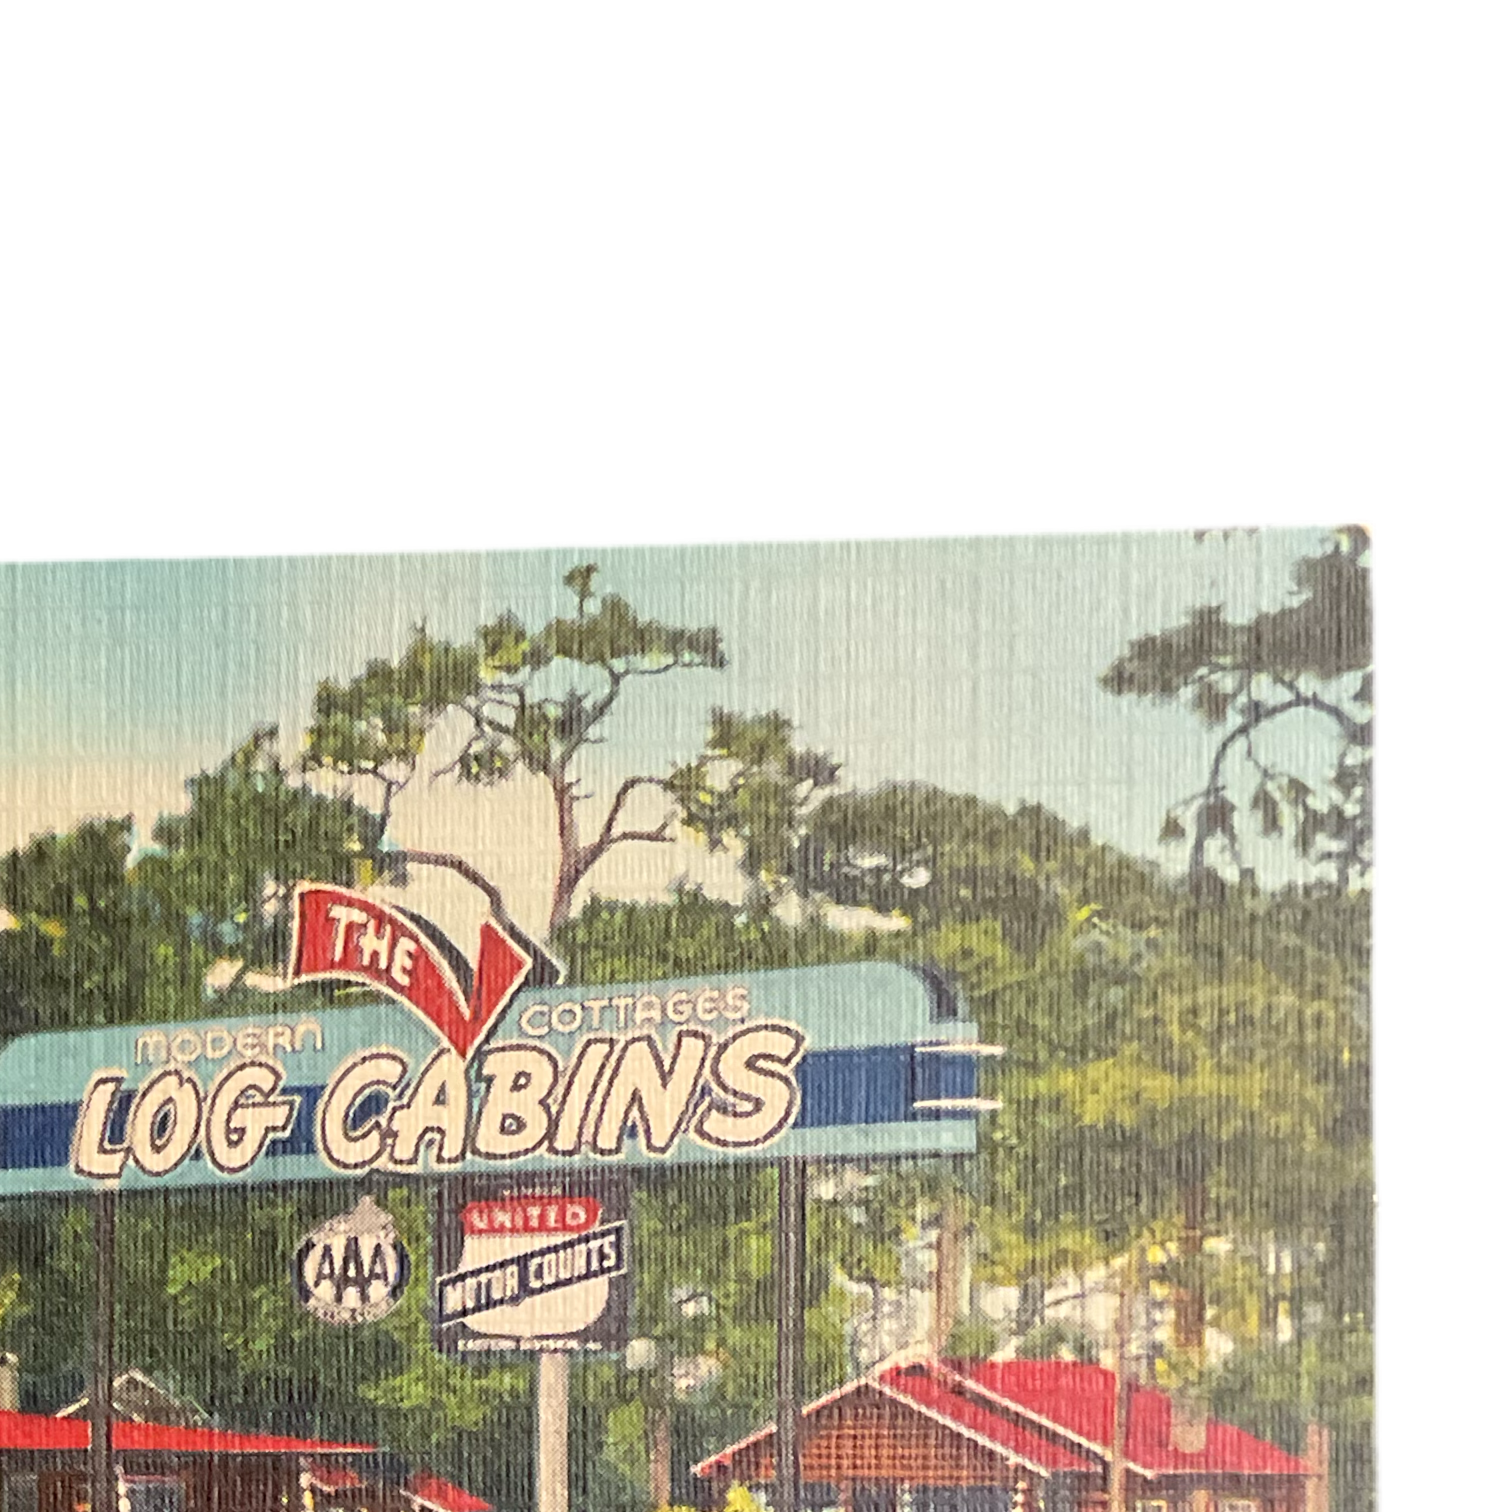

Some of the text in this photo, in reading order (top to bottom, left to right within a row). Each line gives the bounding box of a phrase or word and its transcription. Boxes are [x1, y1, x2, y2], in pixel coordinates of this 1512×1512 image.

[328, 903, 418, 987] THE
[135, 986, 751, 1064] MODERN COTTAGES
[71, 1018, 806, 1180] LOG CABINS
[470, 1203, 588, 1230] UNITED
[313, 1235, 390, 1305] AAA
[527, 1234, 618, 1289] COURTS
